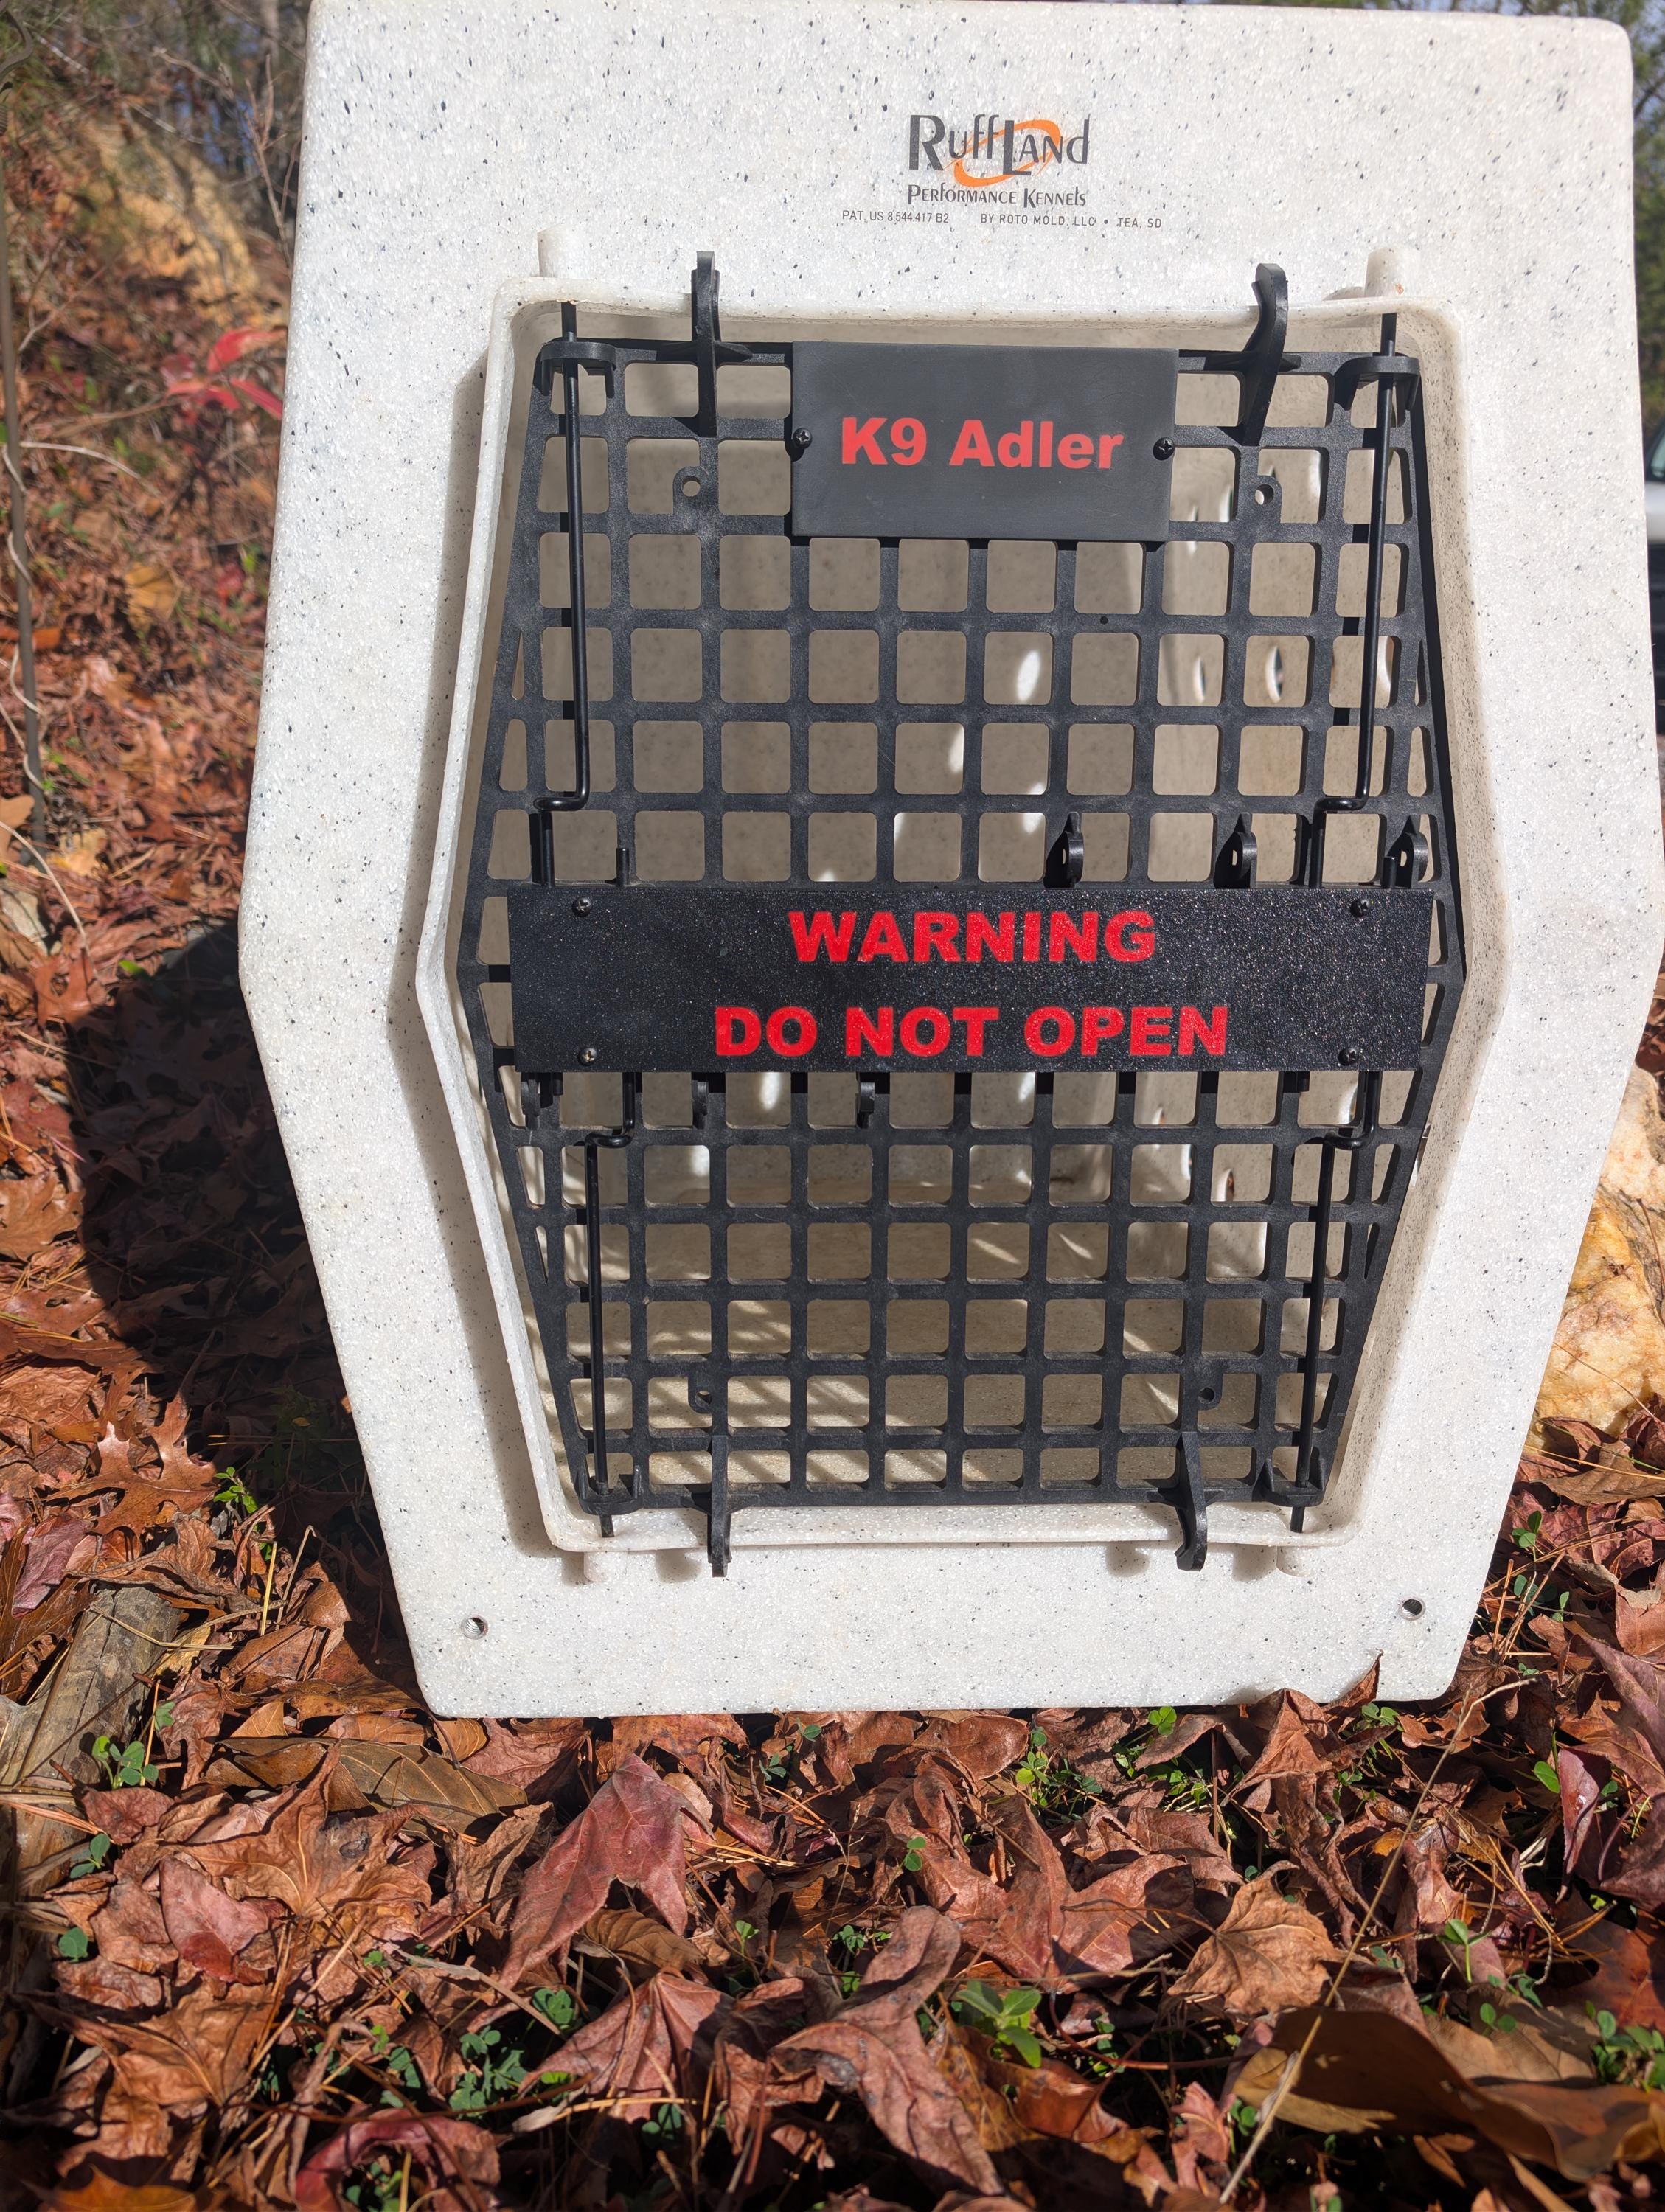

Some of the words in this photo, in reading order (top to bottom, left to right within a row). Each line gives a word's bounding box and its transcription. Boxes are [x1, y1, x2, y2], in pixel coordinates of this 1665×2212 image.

[869, 211, 884, 221] US
[936, 212, 949, 223] B2
[981, 213, 995, 223] BY
[999, 214, 1029, 225] ROTO
[1074, 216, 1096, 226] LLC
[1147, 218, 1162, 229] SD
[841, 417, 928, 466] K9
[948, 419, 1125, 470] Adler
[788, 911, 1156, 963] WARNING
[715, 1006, 817, 1057] DO
[844, 1006, 1001, 1057] NOT
[1022, 1006, 1229, 1057] OPEN
